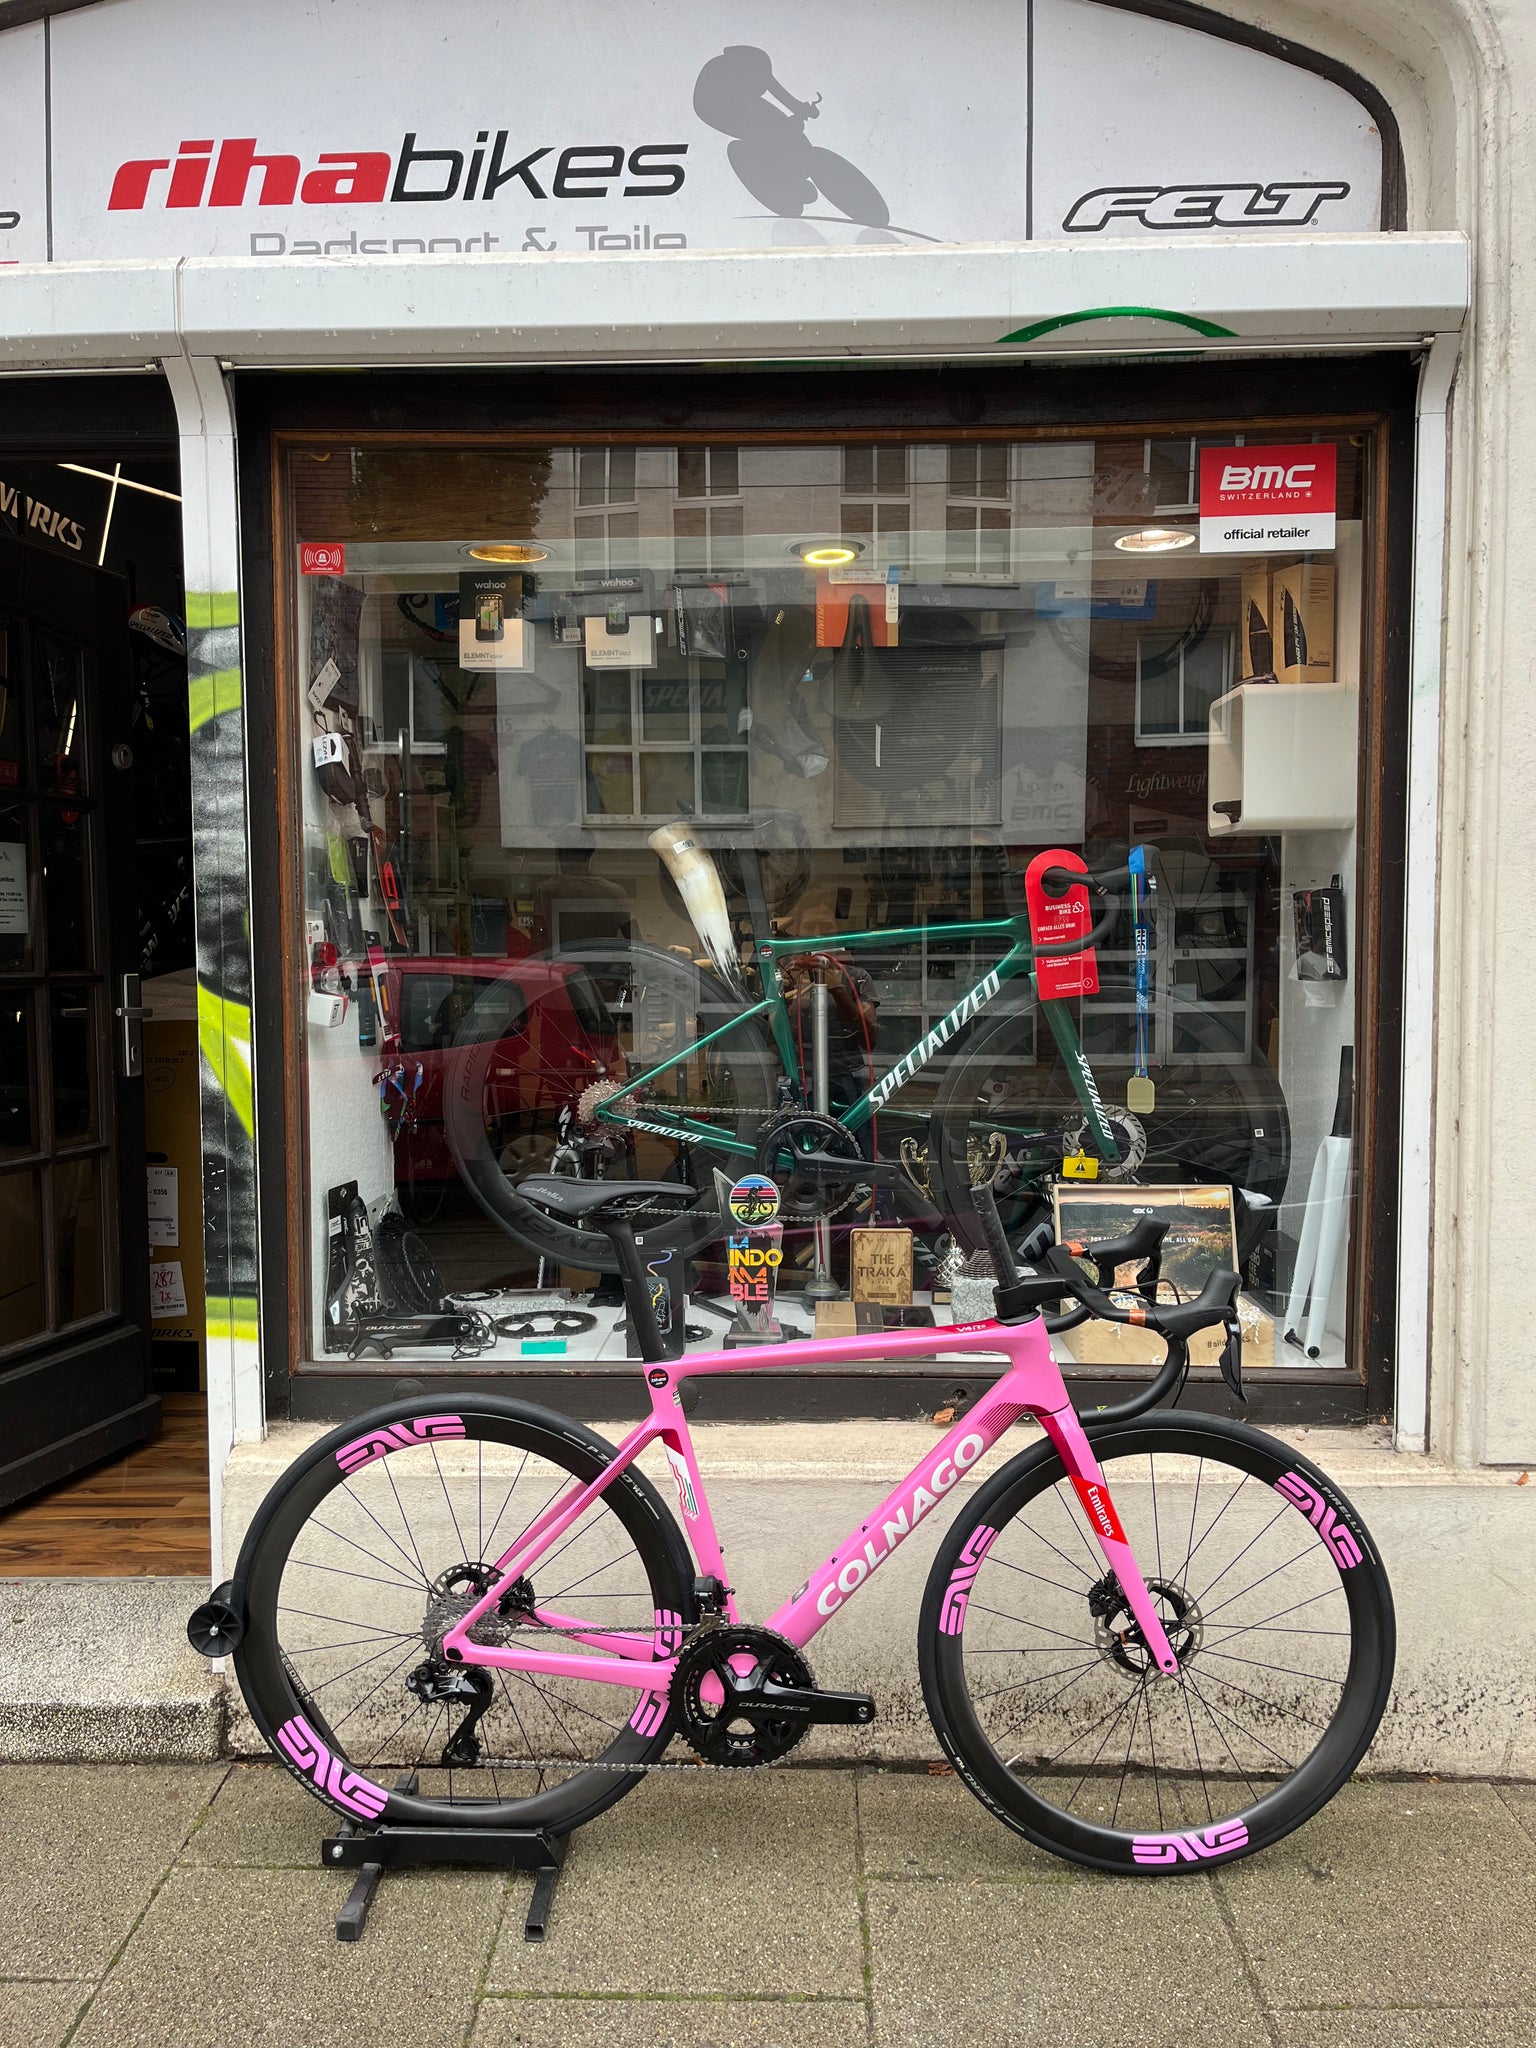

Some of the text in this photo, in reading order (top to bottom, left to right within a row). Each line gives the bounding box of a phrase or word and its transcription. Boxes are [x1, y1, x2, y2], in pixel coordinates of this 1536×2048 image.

[1220, 464, 1316, 491] BMC
[1219, 491, 1301, 501] SWITZERLAND
[1223, 527, 1311, 540] official retailer
[474, 580, 507, 589] wahoo
[600, 578, 634, 587] wahoo
[1045, 903, 1071, 912] BUSINESS
[1321, 897, 1334, 974] ceramicspeed
[867, 969, 1001, 1114] SPECIALIZED
[1074, 1050, 1115, 1140] SPECIALIZED
[626, 1118, 704, 1144] SPECIALIZED
[730, 1236, 749, 1248] LA
[729, 1248, 783, 1267] INDO
[870, 1254, 895, 1265] THE
[729, 1267, 768, 1284] MA
[858, 1266, 908, 1278] TRAKA
[730, 1283, 769, 1301] BLE
[683, 1509, 700, 1522] UAE
[1087, 1485, 1115, 1537] Emirates
[1321, 1486, 1362, 1533] PIRELLI
[816, 1433, 985, 1618] COLNAGO
[738, 1700, 811, 1713] DURA-ACE
[286, 1763, 335, 1805] PIRELLI
[963, 1771, 996, 1806] ZERO
